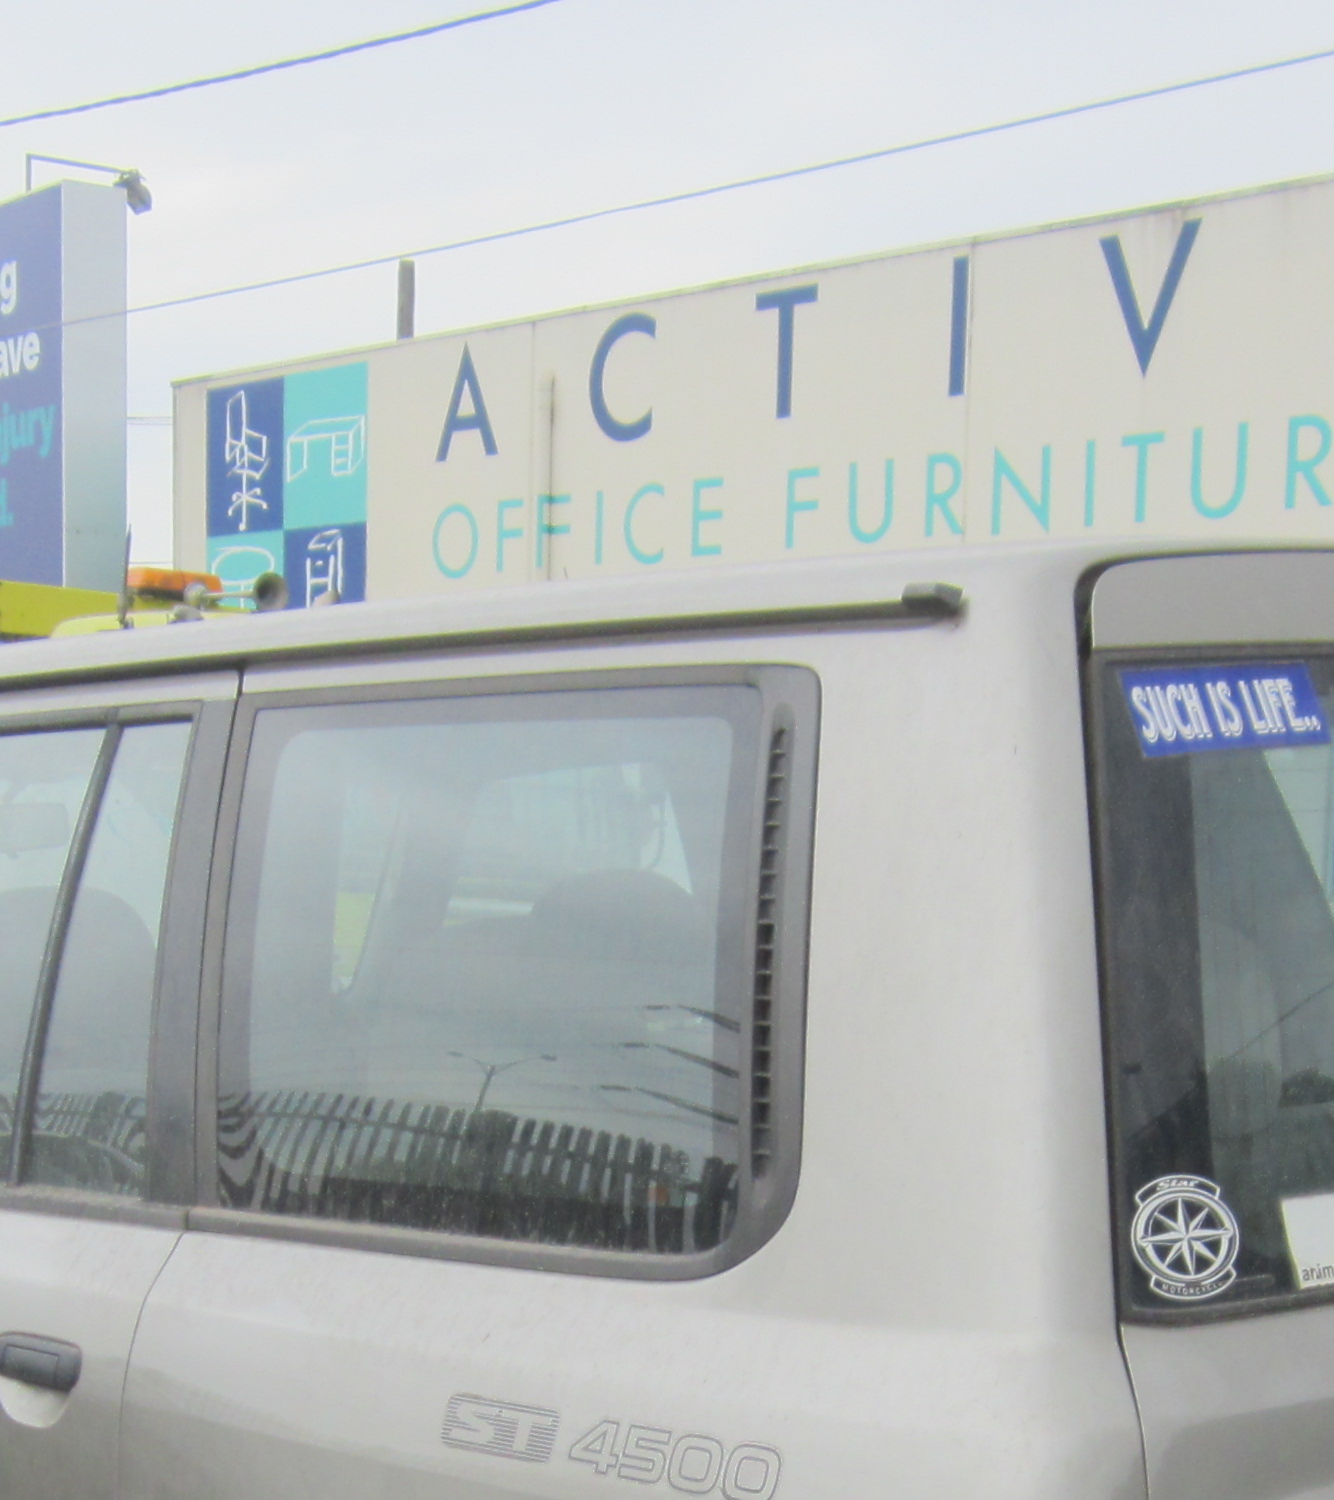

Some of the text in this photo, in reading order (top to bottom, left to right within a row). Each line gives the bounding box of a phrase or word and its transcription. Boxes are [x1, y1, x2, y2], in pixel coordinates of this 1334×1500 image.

[432, 476, 724, 580] OFFICE
[1131, 683, 1213, 743] SUCH
[1205, 681, 1243, 737] IS
